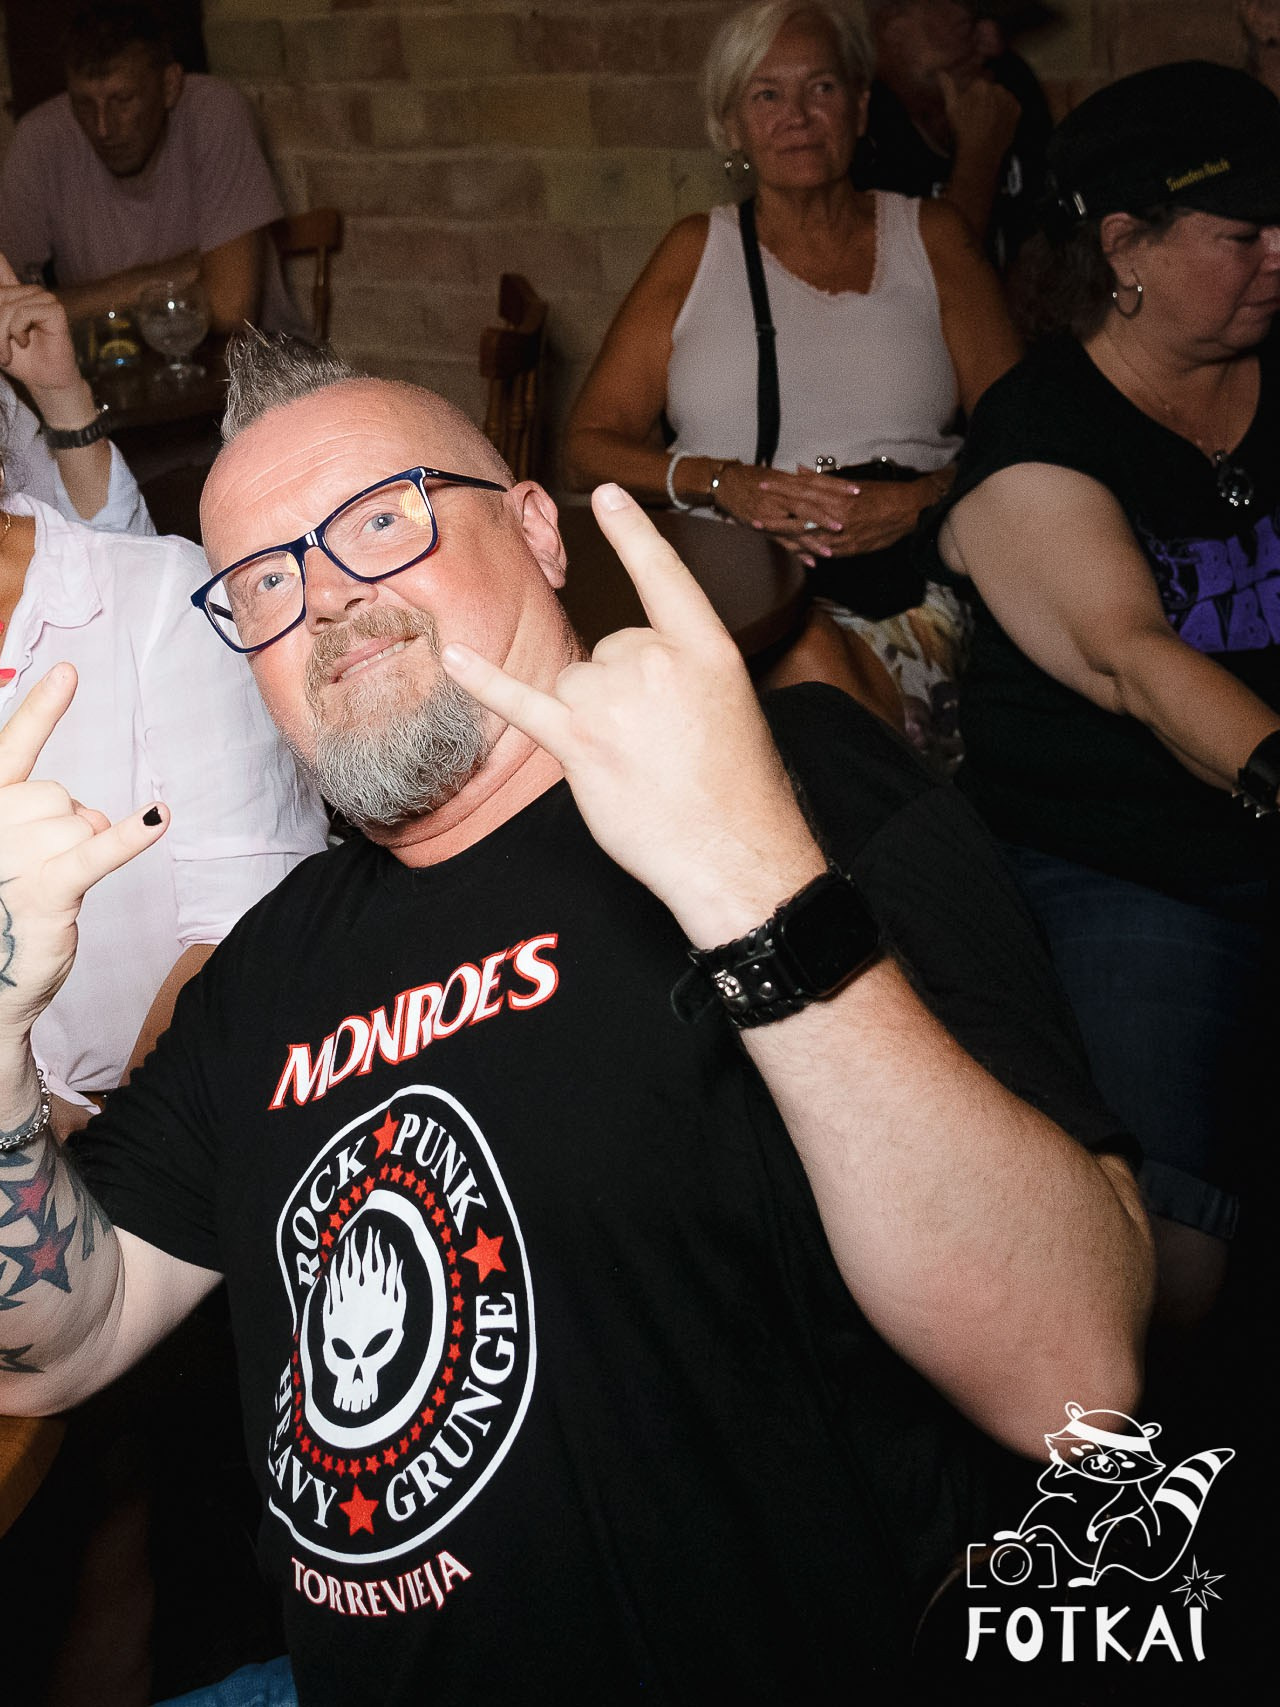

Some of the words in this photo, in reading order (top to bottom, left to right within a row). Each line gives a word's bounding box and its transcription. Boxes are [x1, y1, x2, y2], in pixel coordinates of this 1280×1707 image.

[268, 933, 559, 1110] MONROE'S
[292, 1136, 367, 1288] ROCK
[389, 1113, 488, 1236] PUNK
[385, 1291, 518, 1522] GRUNGE
[291, 1551, 472, 1617] TORREVIEJA
